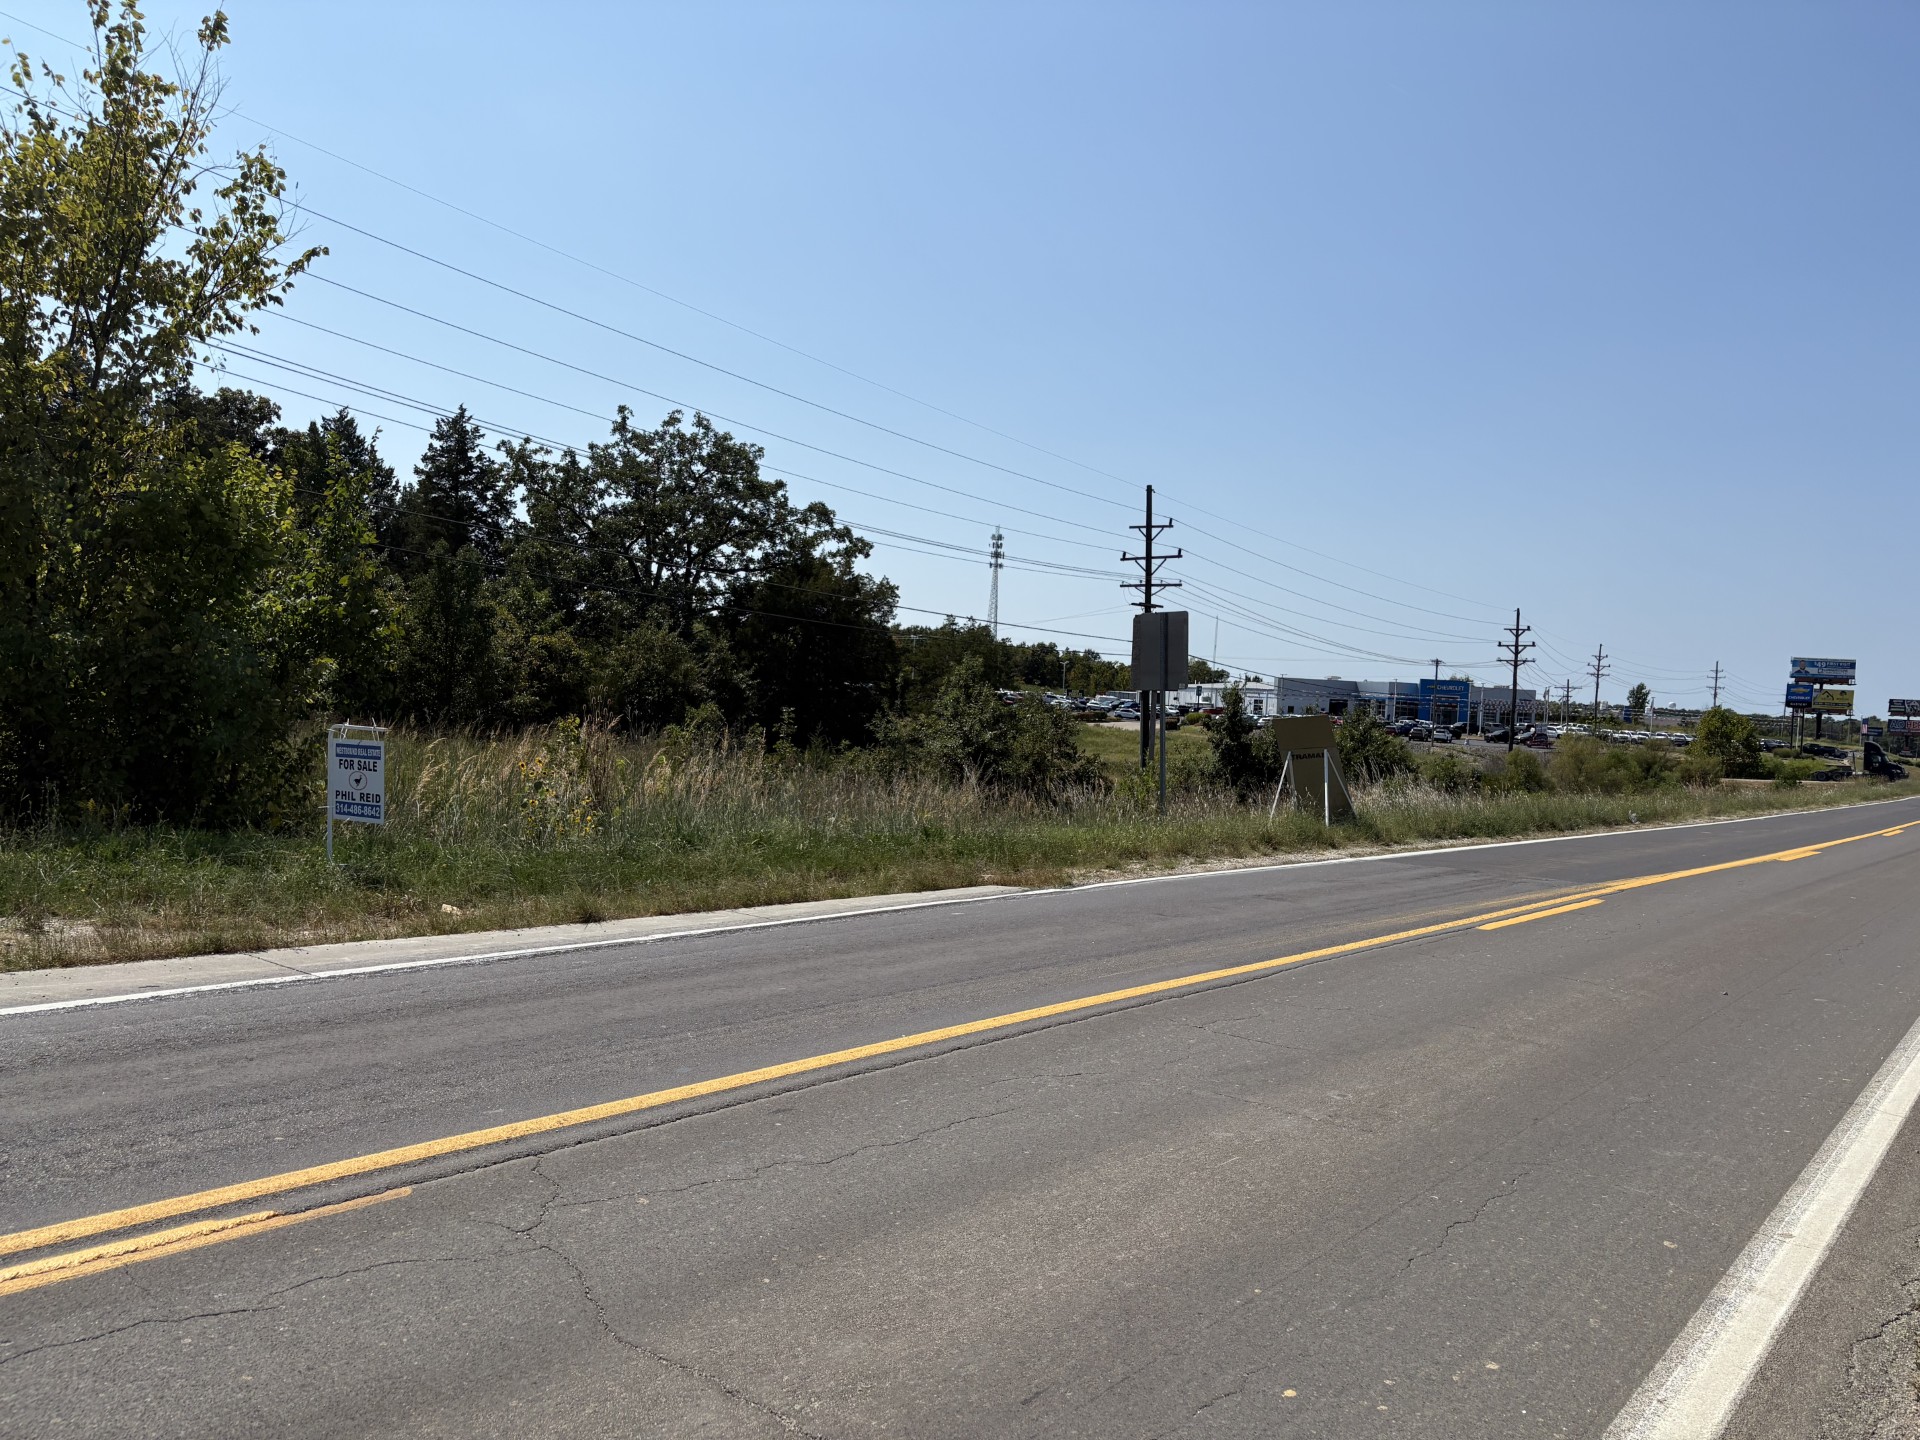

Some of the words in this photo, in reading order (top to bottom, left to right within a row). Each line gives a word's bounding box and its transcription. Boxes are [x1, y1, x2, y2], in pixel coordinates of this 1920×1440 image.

[339, 759, 355, 771] FOR
[357, 760, 378, 772] SALE
[335, 790, 356, 801] PHIL
[359, 793, 381, 803] REID
[336, 803, 380, 816] 314-486-8642
